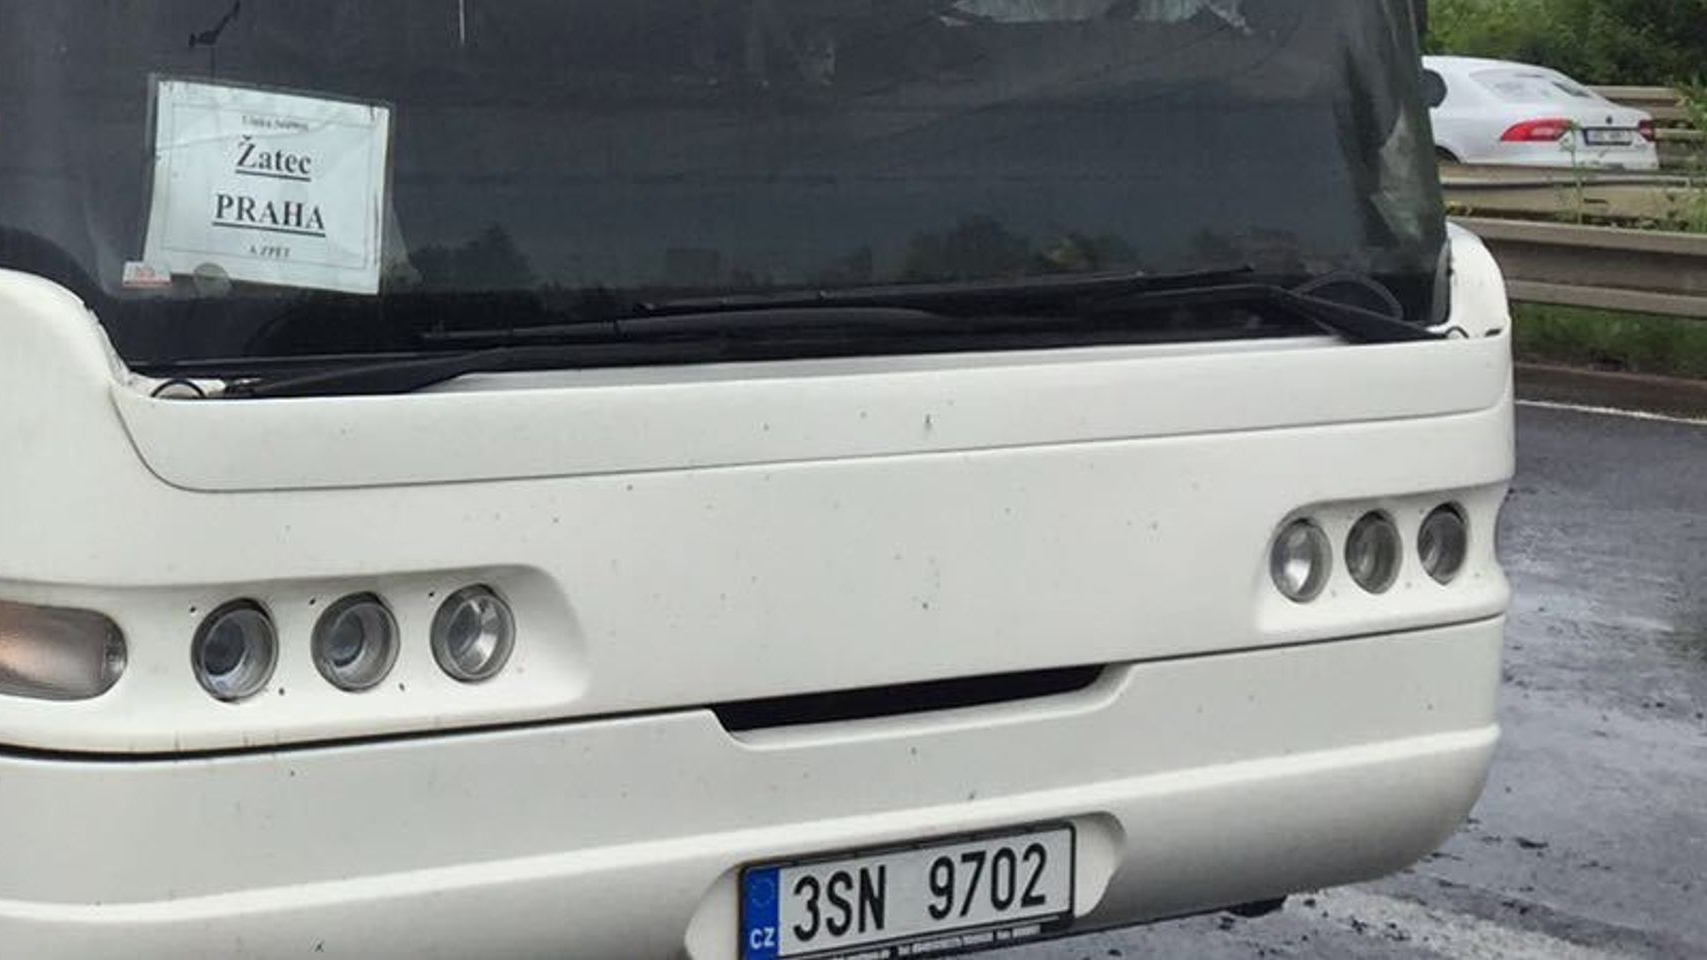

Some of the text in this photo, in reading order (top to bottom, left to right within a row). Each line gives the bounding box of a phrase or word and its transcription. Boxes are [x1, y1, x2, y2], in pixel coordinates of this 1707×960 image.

[236, 134, 312, 175] Žatec
[215, 193, 325, 230] PRAHA
[793, 864, 887, 942] 3SN
[927, 843, 1047, 920] 9702
[750, 927, 775, 949] CZ
